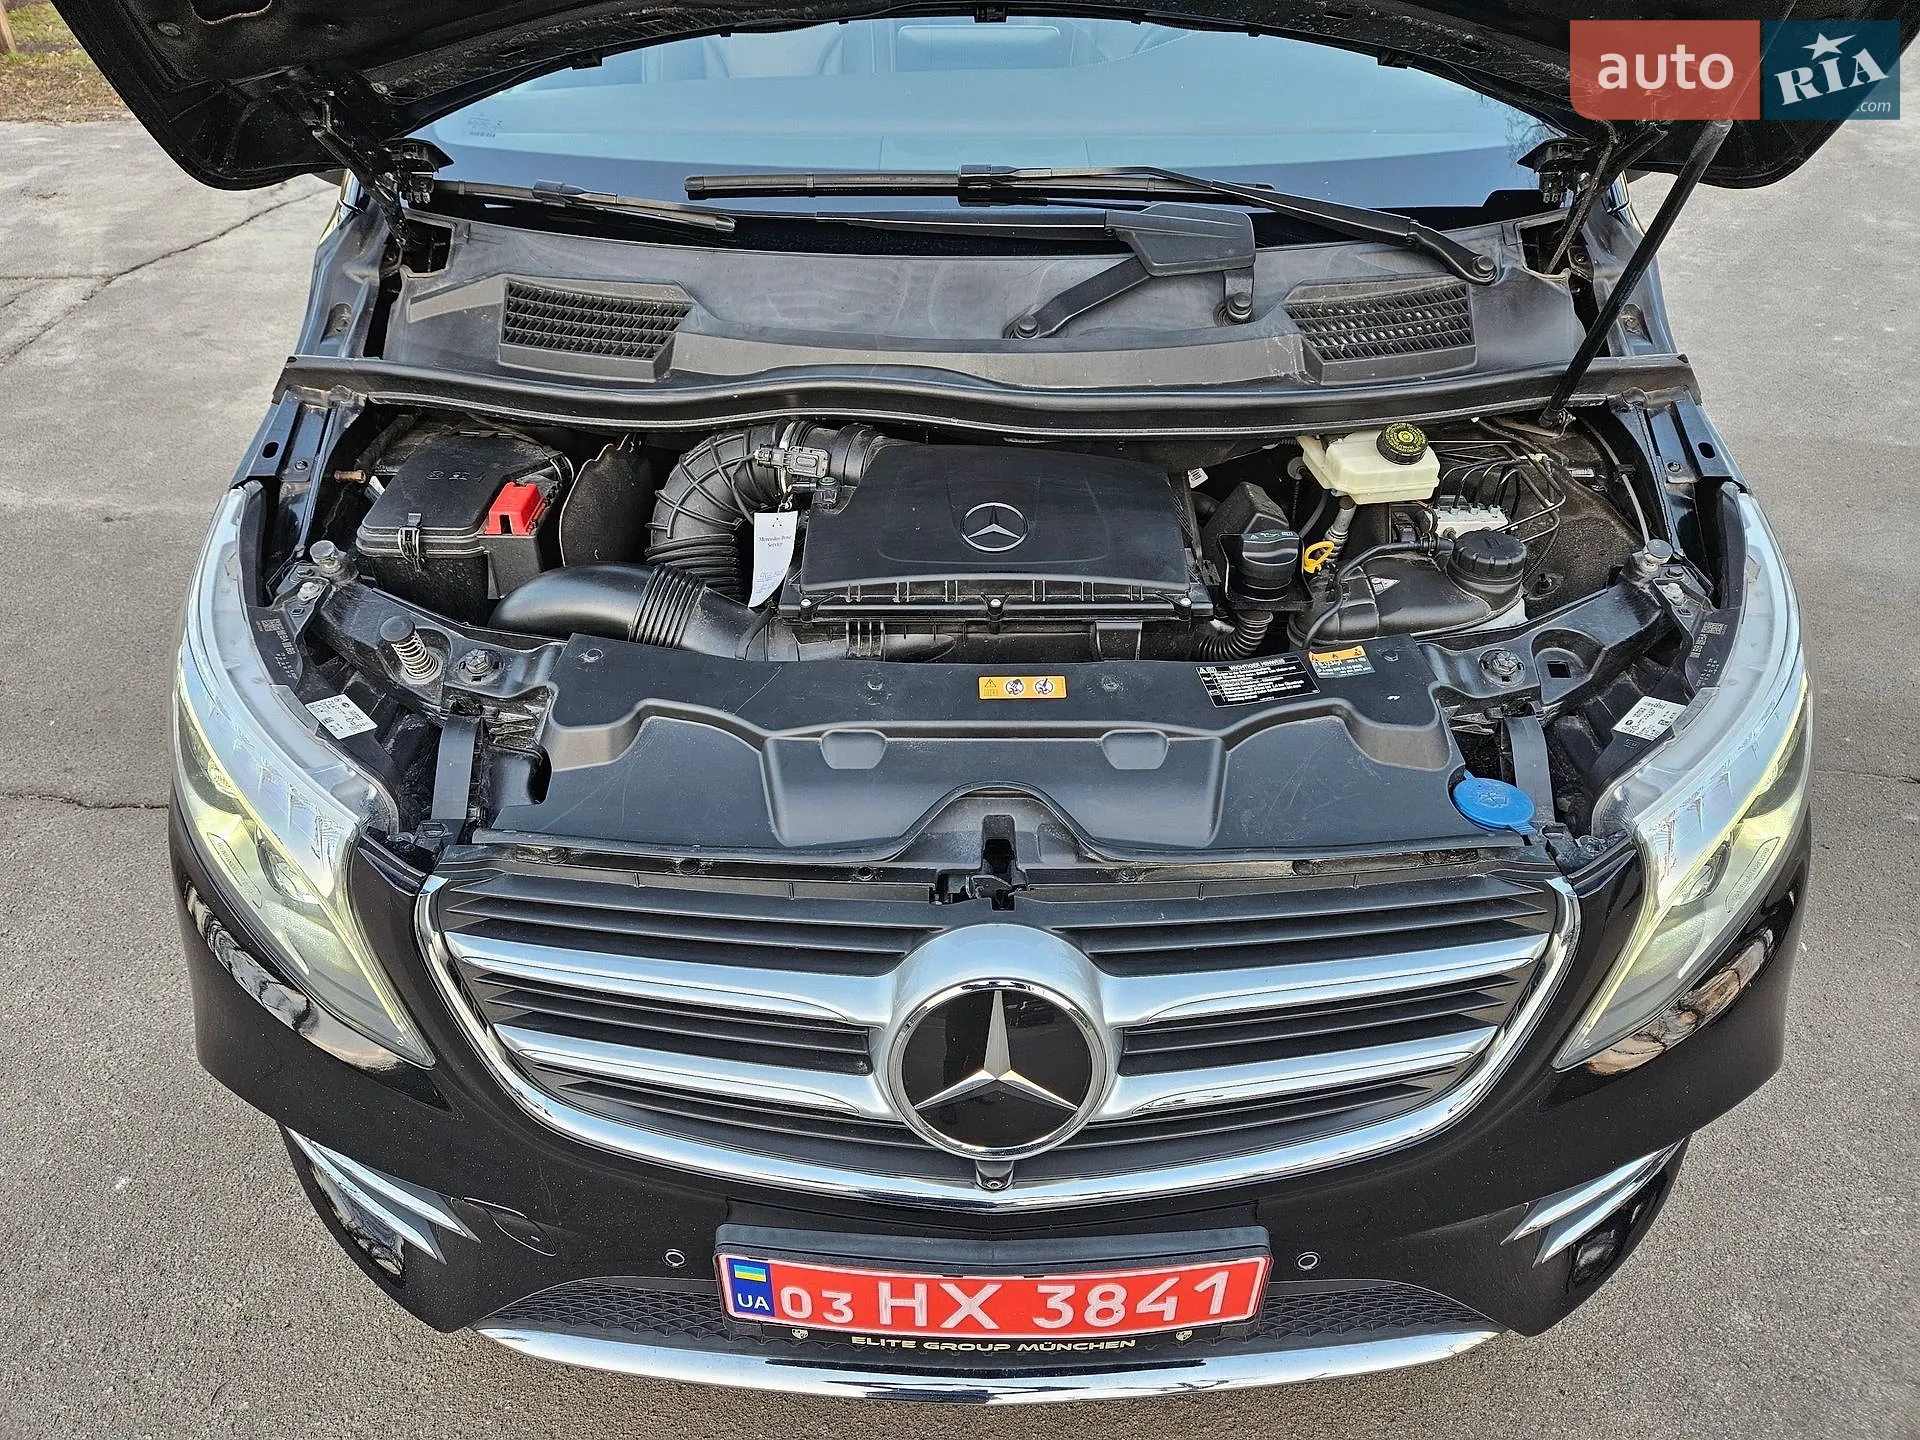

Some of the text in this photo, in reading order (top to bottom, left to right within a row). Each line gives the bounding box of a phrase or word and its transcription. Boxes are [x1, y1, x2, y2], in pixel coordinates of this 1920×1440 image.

[737, 1293, 771, 1312] UA
[780, 1271, 1230, 1330] 03 HX 3841
[851, 1336, 1137, 1352] ELITE GROUP MÜNCHEN
